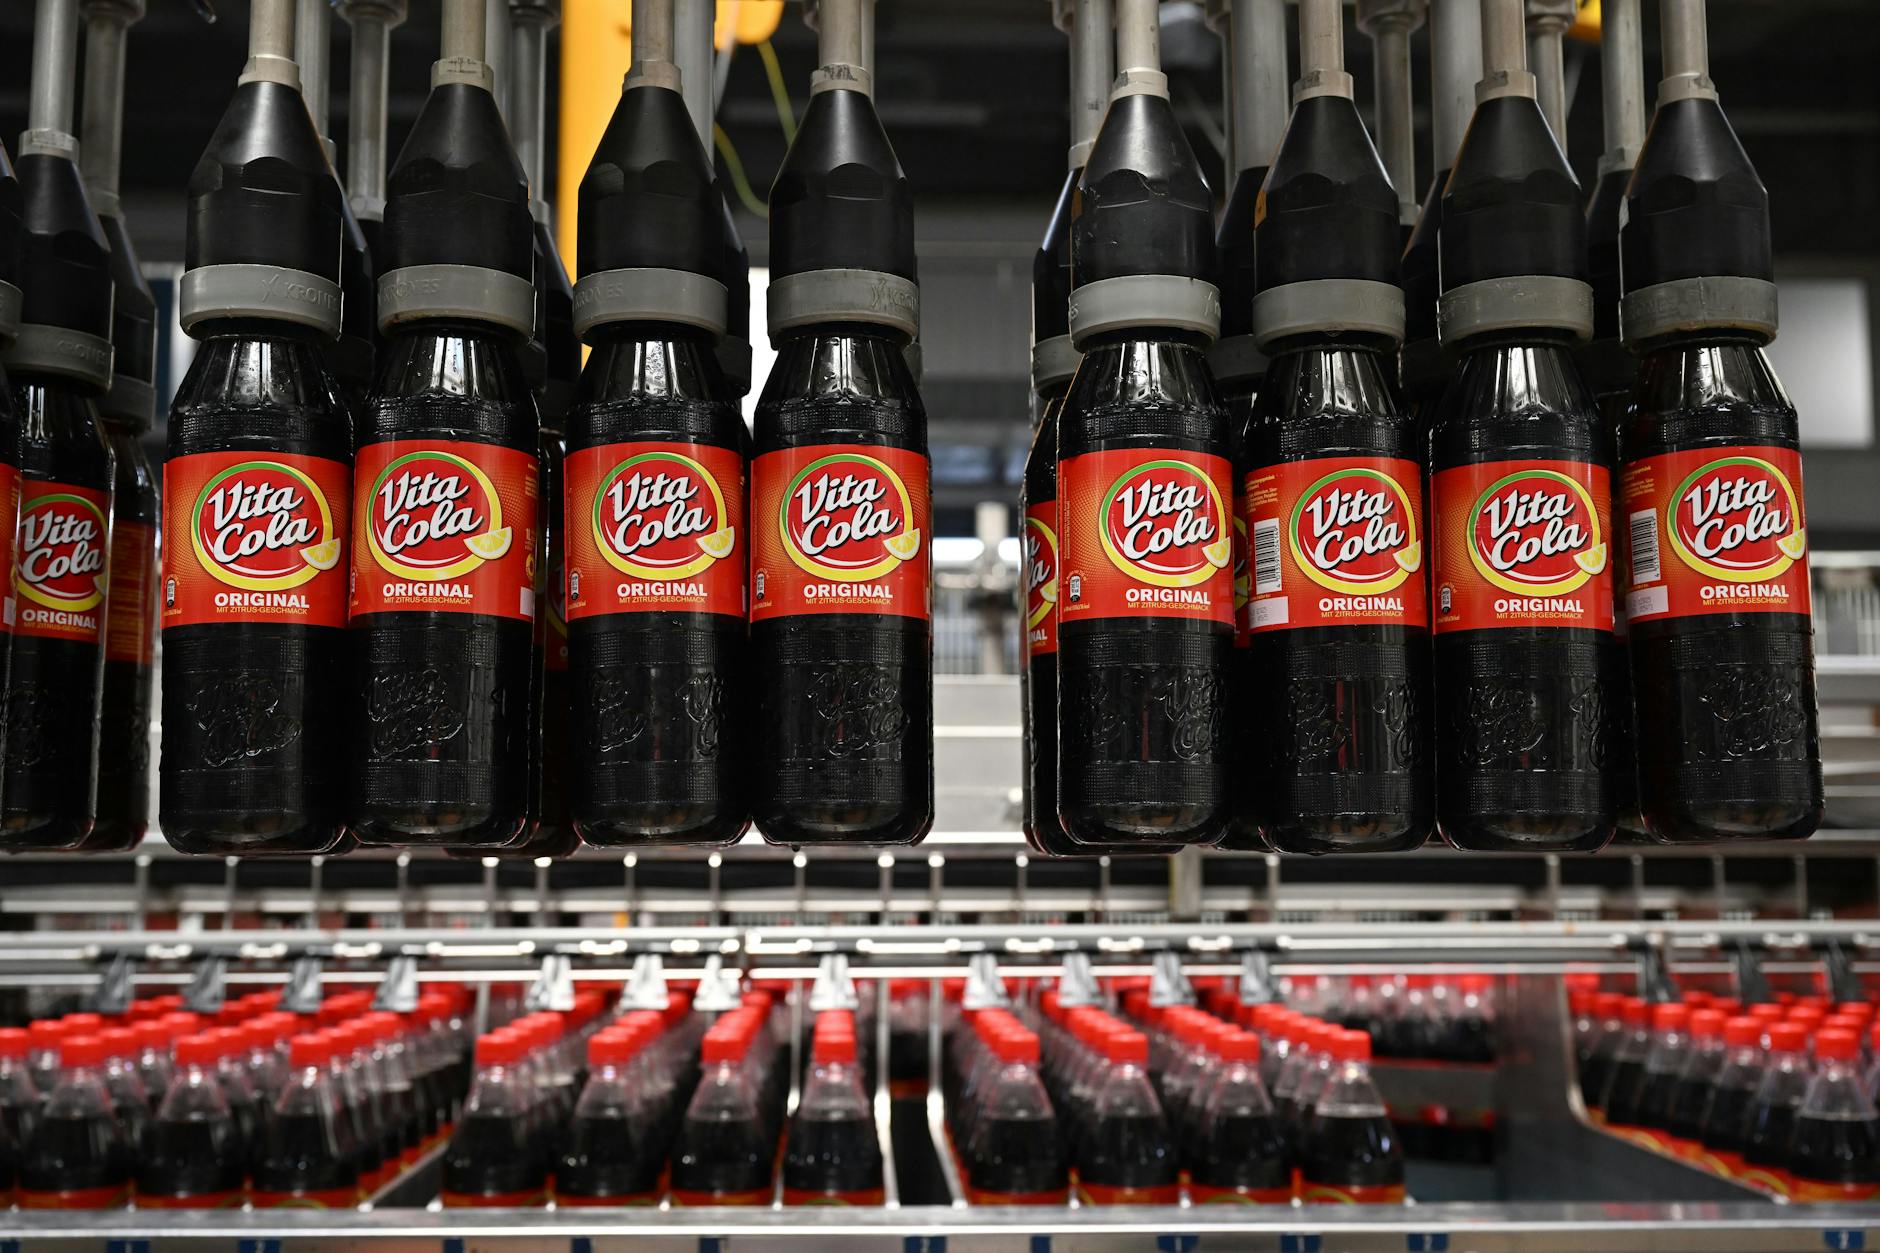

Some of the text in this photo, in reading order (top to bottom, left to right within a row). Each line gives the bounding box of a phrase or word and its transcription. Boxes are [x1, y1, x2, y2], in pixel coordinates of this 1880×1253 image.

[207, 480, 304, 530] Vita
[379, 472, 469, 521] Vita
[607, 473, 699, 521] Vita
[795, 474, 885, 523] Vita
[1116, 480, 1205, 527] Vita
[1305, 489, 1392, 537] Vita
[1484, 491, 1575, 538] Vita
[1685, 478, 1776, 526] Vita
[20, 511, 98, 552] Vita
[212, 510, 317, 563] Cola
[385, 500, 483, 554] Cola
[614, 500, 712, 554] Cola
[800, 501, 899, 555] Cola
[1123, 508, 1215, 560] Cola
[1313, 516, 1405, 570] Cola
[1491, 517, 1588, 570] Cola
[1693, 503, 1790, 558] Cola
[22, 541, 104, 583] Cola
[214, 592, 310, 609] ORIGINAL
[216, 605, 309, 615] MIT ZITRUS-GESCHMACK
[382, 582, 474, 597] ORIGINAL
[384, 595, 471, 604] MIT ZITRUS-GESCHMACK
[617, 582, 708, 597] ORIGINAL
[619, 595, 706, 604] MIT ZITRUS-GESCHMACK
[803, 583, 894, 598] ORIGINAL
[805, 596, 892, 605] MIT ZITRUS-GESCHMACK
[1125, 588, 1211, 605] ORIGINAL
[1127, 602, 1209, 611] MIT ZITRUS-GESCHMACK
[1318, 597, 1405, 612] ORIGINAL
[1494, 599, 1585, 613] ORIGINAL
[1699, 584, 1789, 598] ORIGINAL
[1714, 596, 1788, 605] ZITRUS-GESCHMACK
[22, 609, 97, 630] ORIGINAL
[1321, 609, 1404, 618] MIT ZITRUS-GESCHMACK
[1496, 610, 1583, 619] MIT ZITRUS-GESCHMACK
